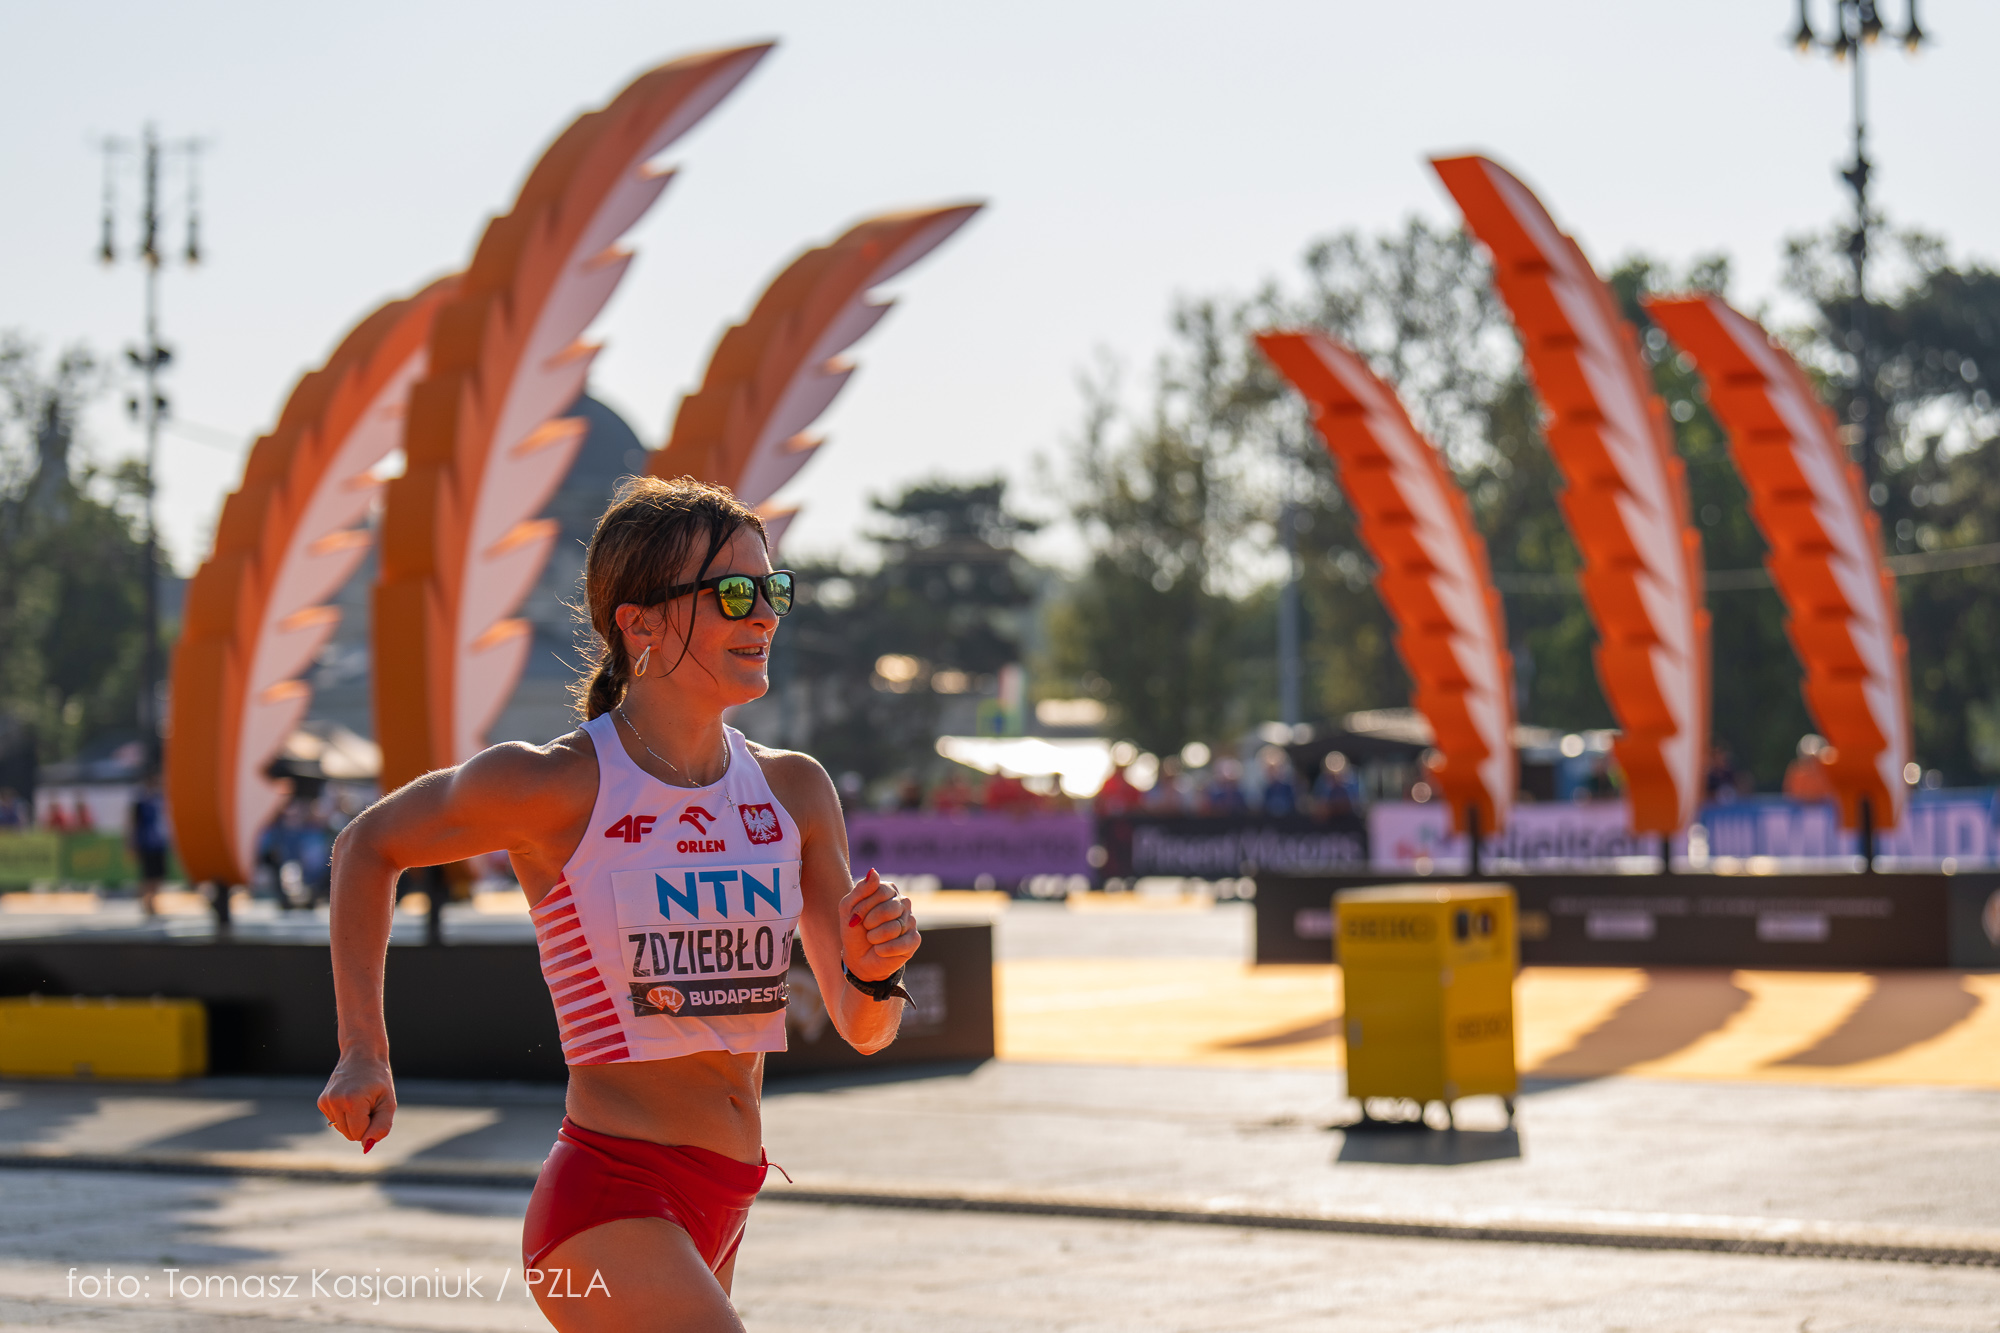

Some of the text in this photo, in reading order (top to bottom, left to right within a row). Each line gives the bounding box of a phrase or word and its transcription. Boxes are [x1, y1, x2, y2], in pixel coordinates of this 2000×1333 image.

[604, 814, 658, 843] 4F
[676, 839, 726, 853] ORLEN
[655, 867, 782, 921] NTN
[628, 926, 773, 977] ZDZIEBŁO
